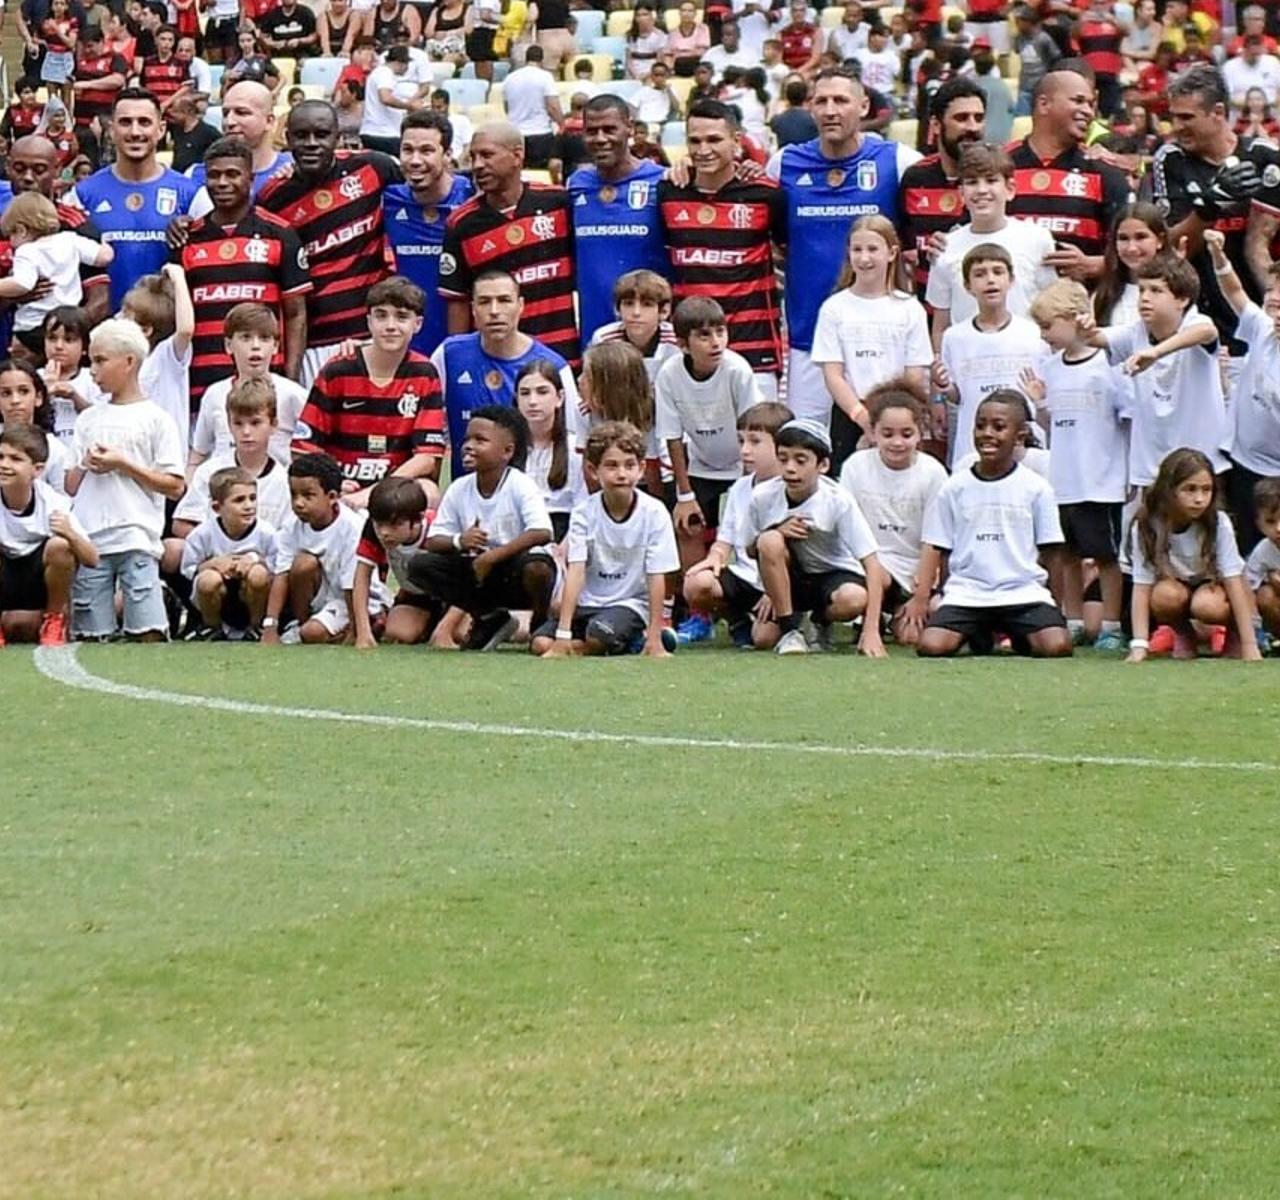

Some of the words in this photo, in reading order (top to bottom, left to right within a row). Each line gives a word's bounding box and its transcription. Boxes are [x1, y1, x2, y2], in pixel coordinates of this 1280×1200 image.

[797, 205, 879, 217] NEXUSGUARD
[397, 245, 443, 255] NEXUSG
[193, 283, 267, 302] FLABET
